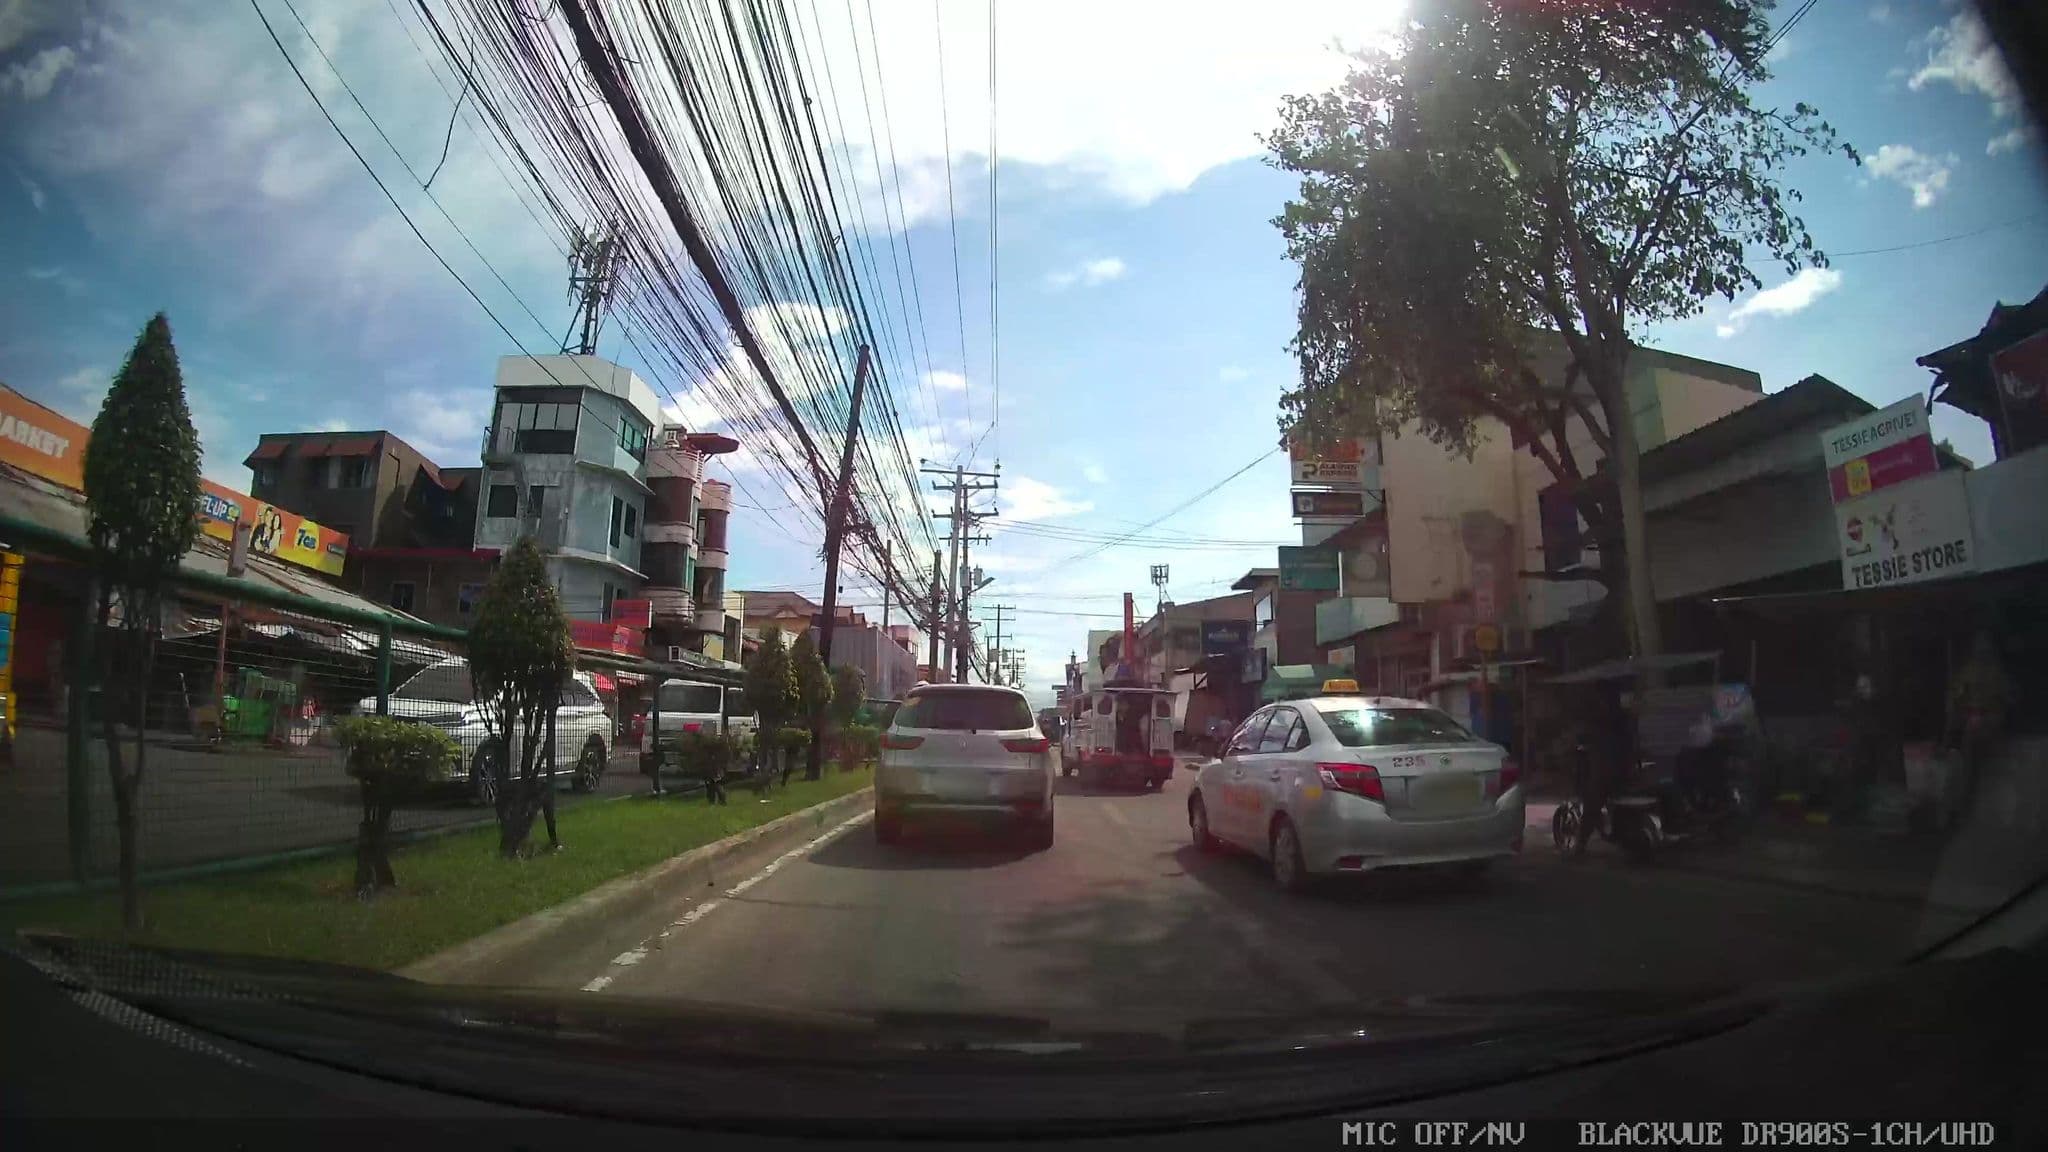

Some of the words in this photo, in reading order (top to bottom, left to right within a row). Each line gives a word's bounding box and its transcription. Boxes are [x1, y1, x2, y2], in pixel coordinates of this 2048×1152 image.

[0, 411, 69, 458] ARKET
[1832, 429, 1869, 454] TESSIE
[1852, 556, 1908, 588] TESSIE
[1912, 539, 1968, 575] STORE
